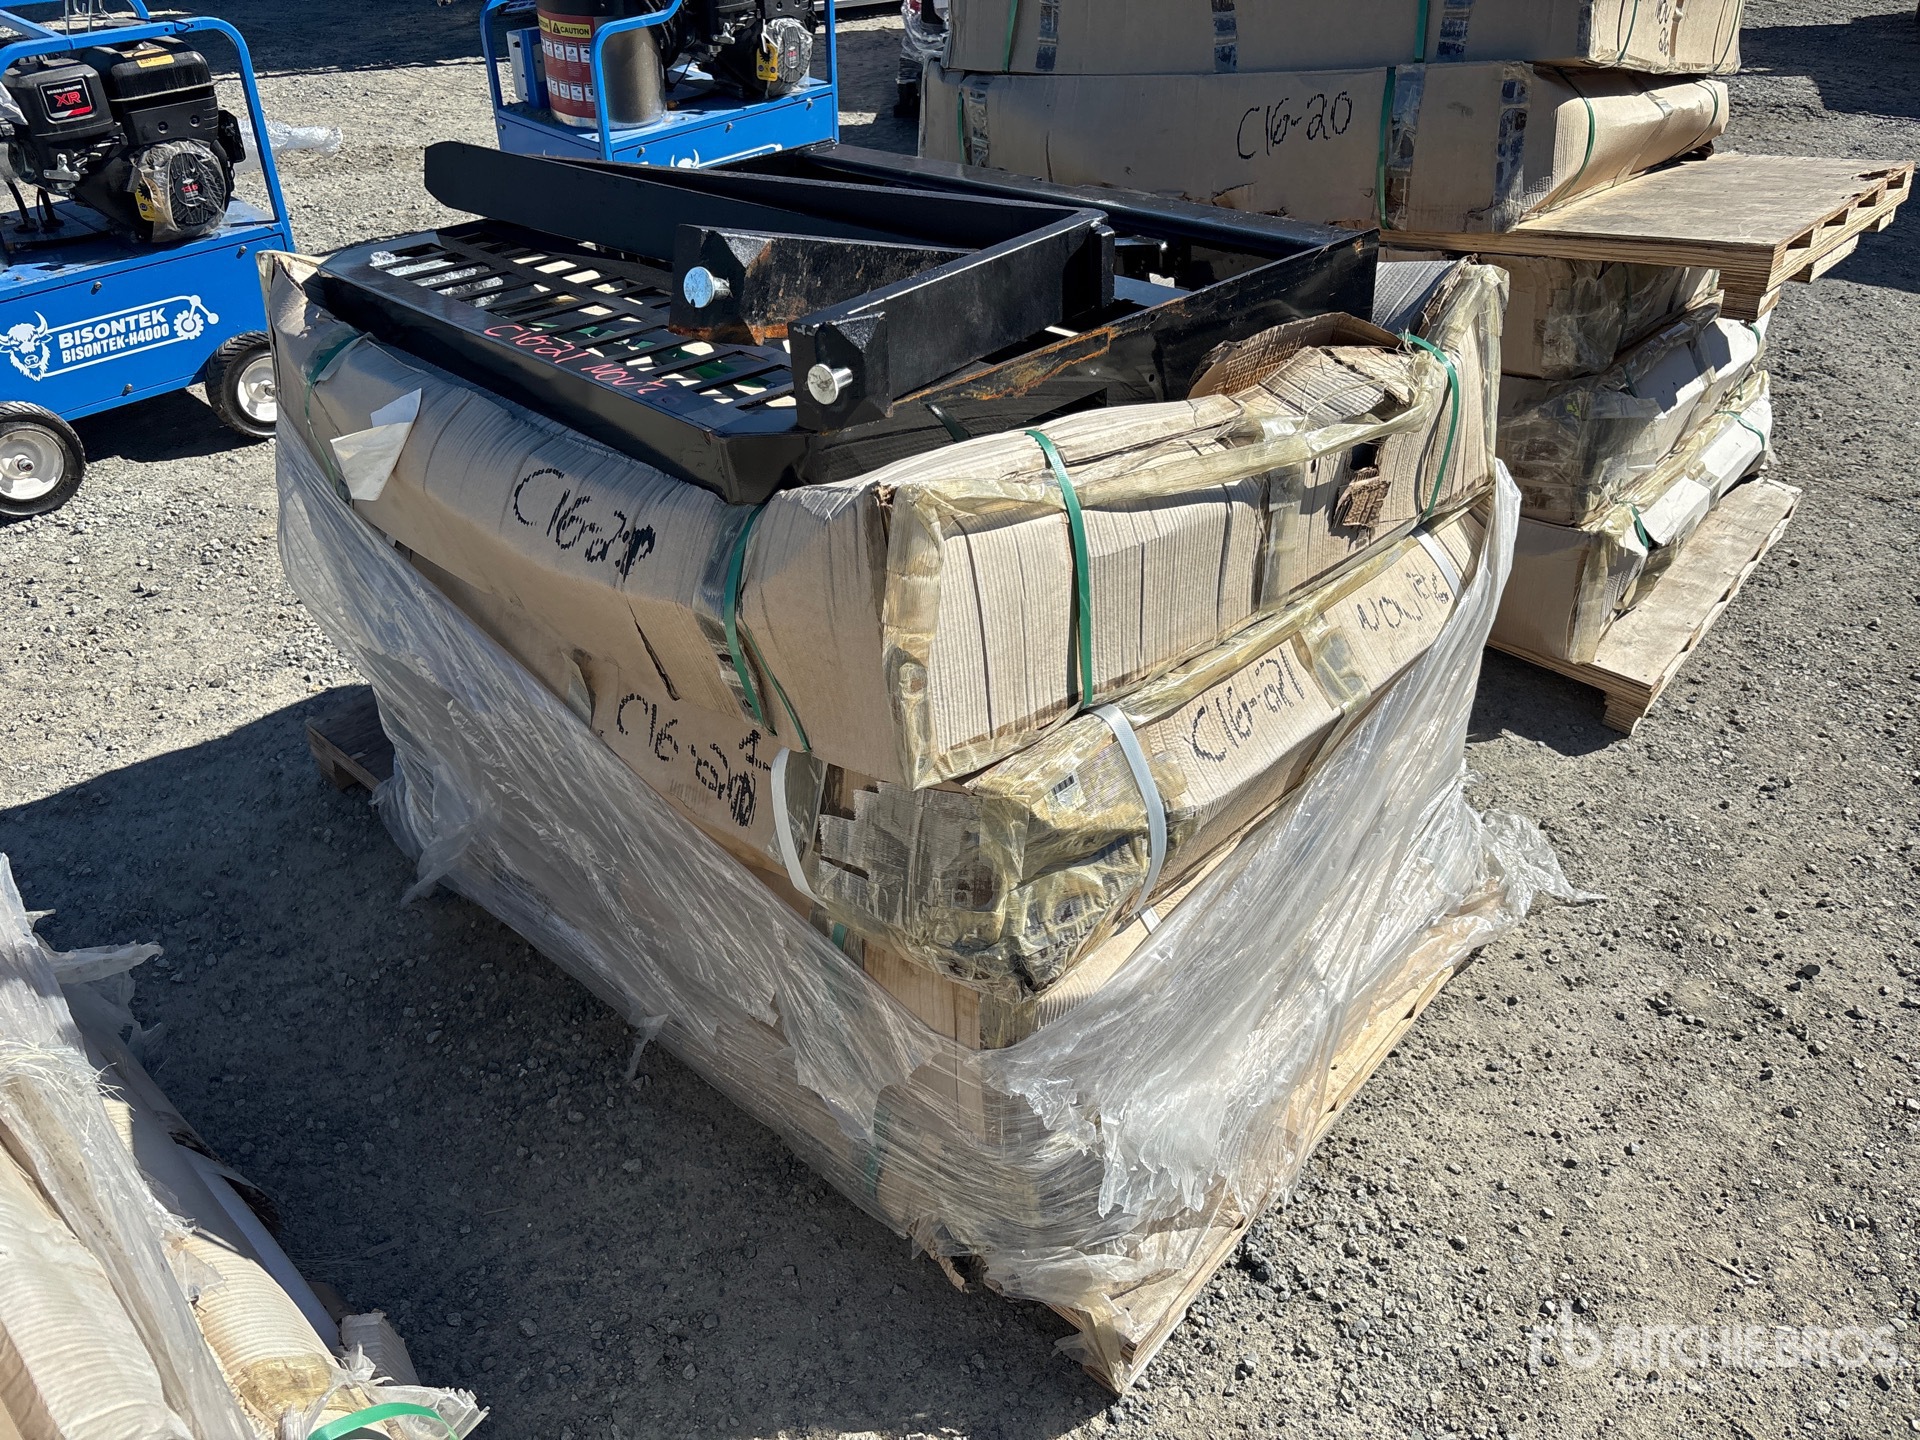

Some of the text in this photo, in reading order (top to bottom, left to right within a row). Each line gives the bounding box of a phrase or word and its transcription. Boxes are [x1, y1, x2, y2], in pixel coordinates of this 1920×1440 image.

[560, 26, 590, 35] CAUTION
[54, 91, 82, 107] XR
[1237, 91, 1352, 159] C16-20
[58, 307, 168, 350] BISONTEK
[61, 323, 170, 364] BISONTEK-H4000
